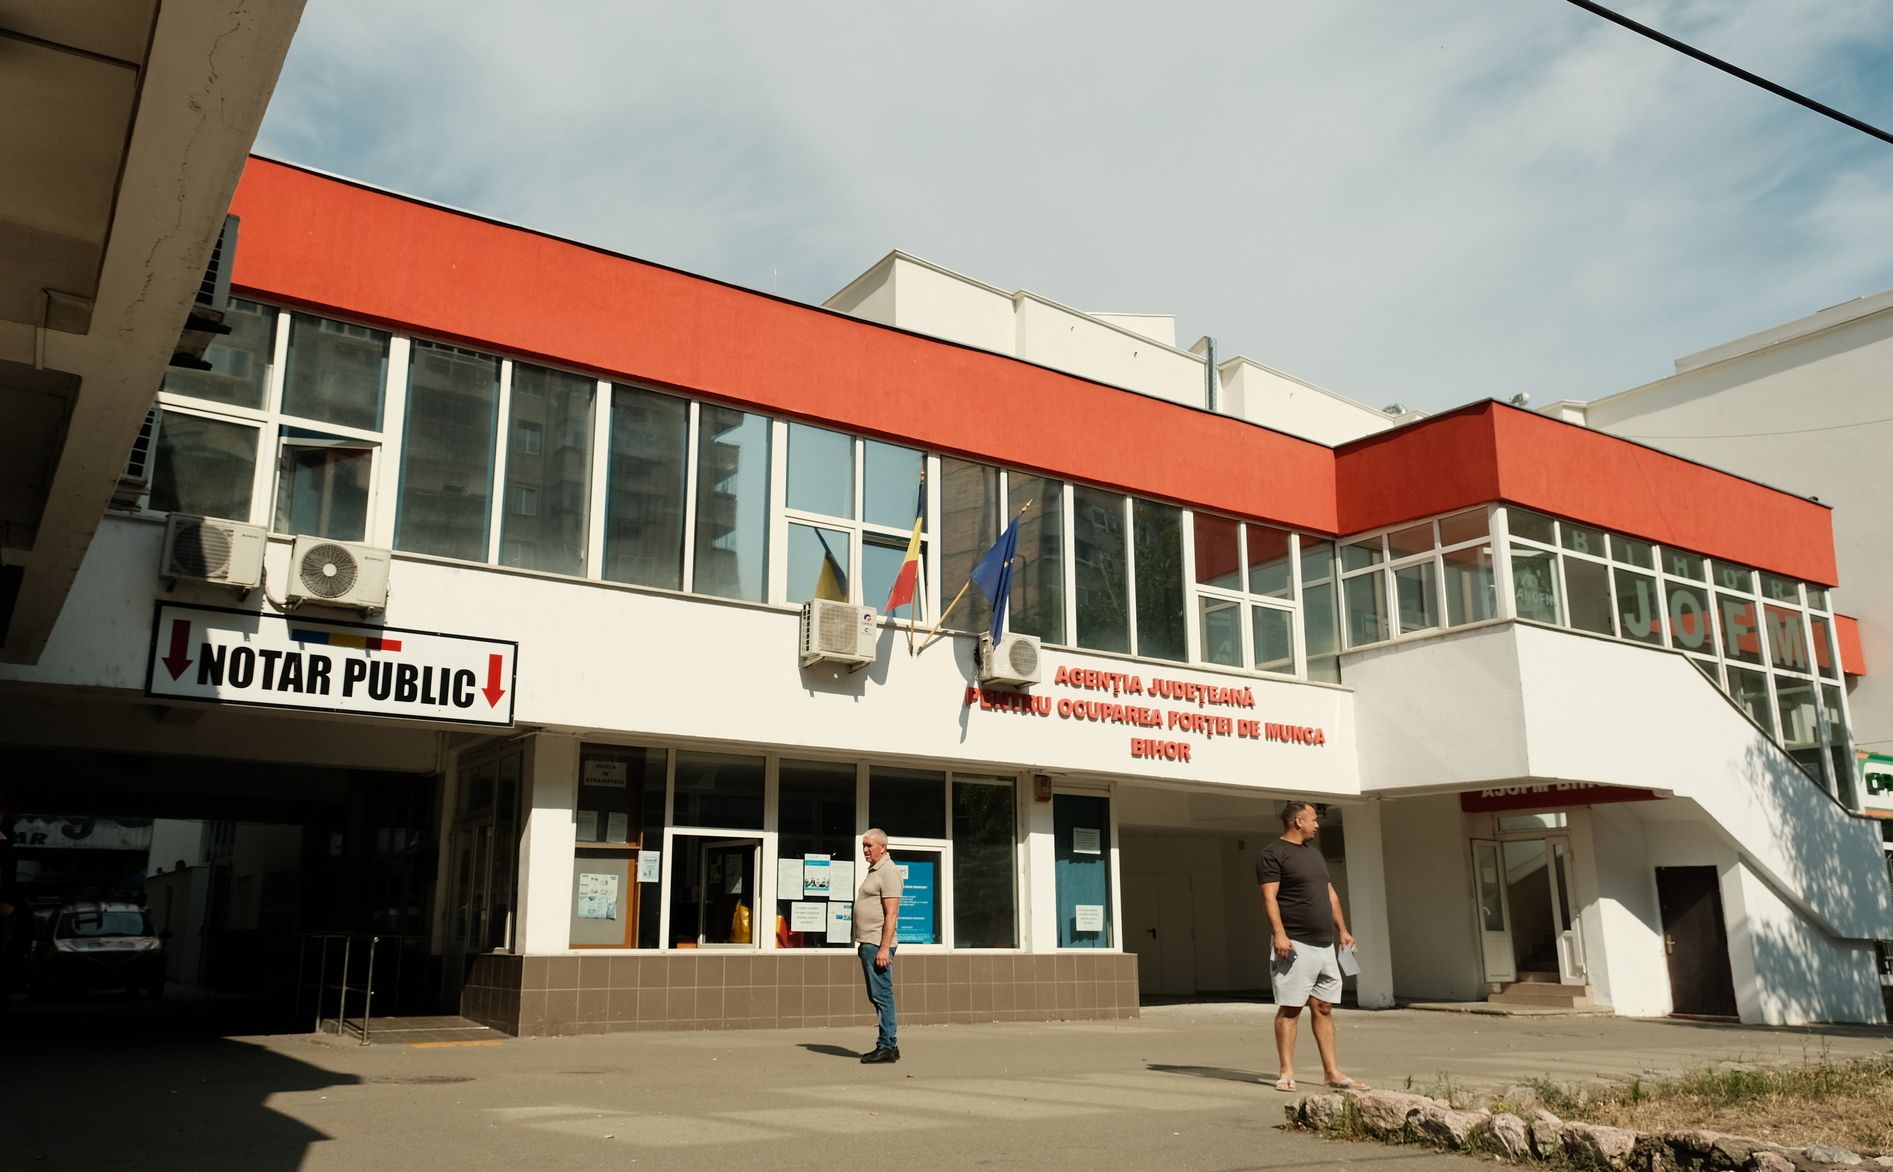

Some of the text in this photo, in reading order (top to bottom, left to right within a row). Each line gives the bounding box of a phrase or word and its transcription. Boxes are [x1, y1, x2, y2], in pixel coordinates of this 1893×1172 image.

[1624, 580, 1807, 669] JOFM
[197, 643, 476, 708] NOTAR PUBLIC
[1055, 665, 1256, 709] AGENȚIA JUDEȚEANĂ
[966, 687, 1052, 717] PENTRU
[1057, 699, 1164, 727] OCUPAREA
[1168, 711, 1233, 738] FORȚEI
[1238, 720, 1261, 739] DE
[1131, 737, 1192, 762] BIHOR
